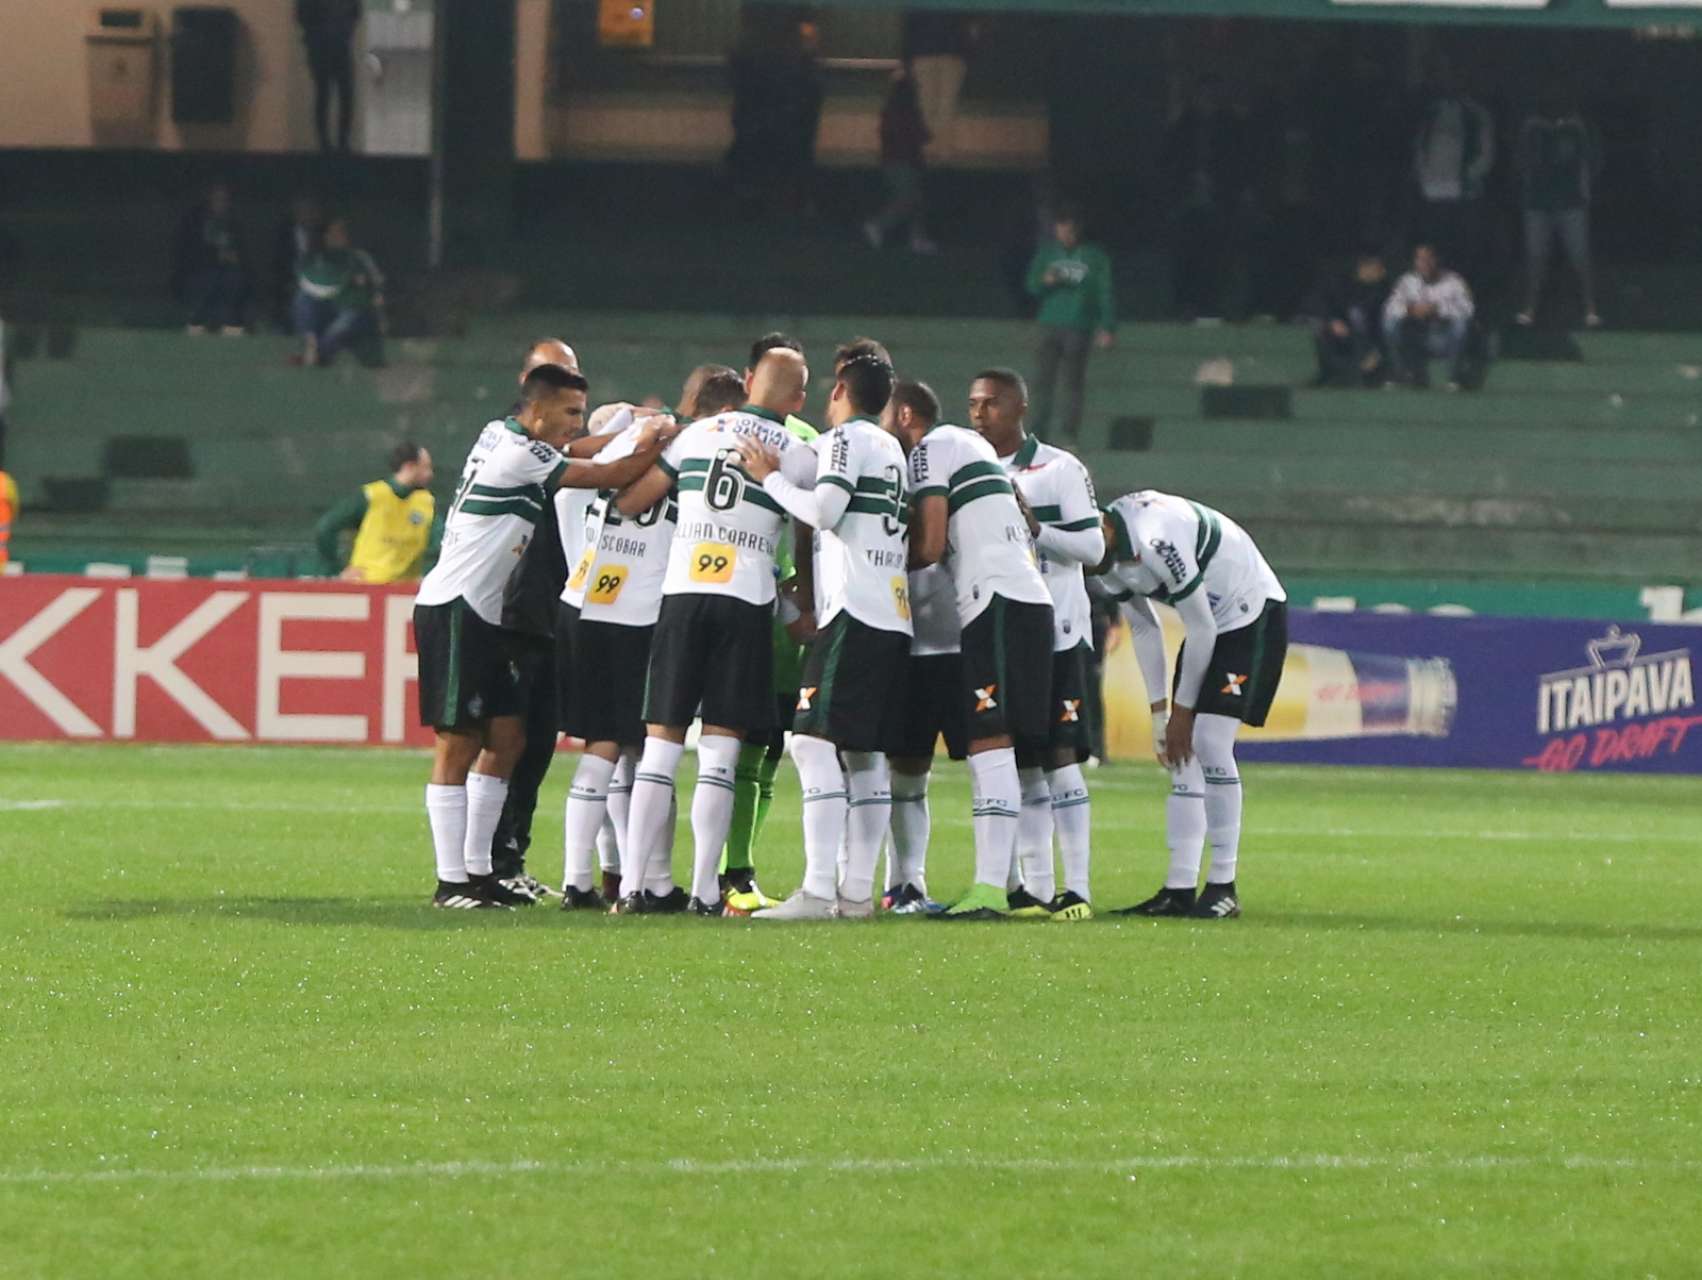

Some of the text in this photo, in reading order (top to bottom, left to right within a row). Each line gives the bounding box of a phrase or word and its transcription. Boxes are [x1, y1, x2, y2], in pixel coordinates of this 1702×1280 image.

[705, 448, 744, 513] 6
[597, 534, 647, 557] SCOBAR
[698, 554, 728, 574] 99
[596, 575, 621, 594] 99
[1537, 655, 1696, 736] ITAIPAVA
[1522, 714, 1702, 773] GO DRAFT
